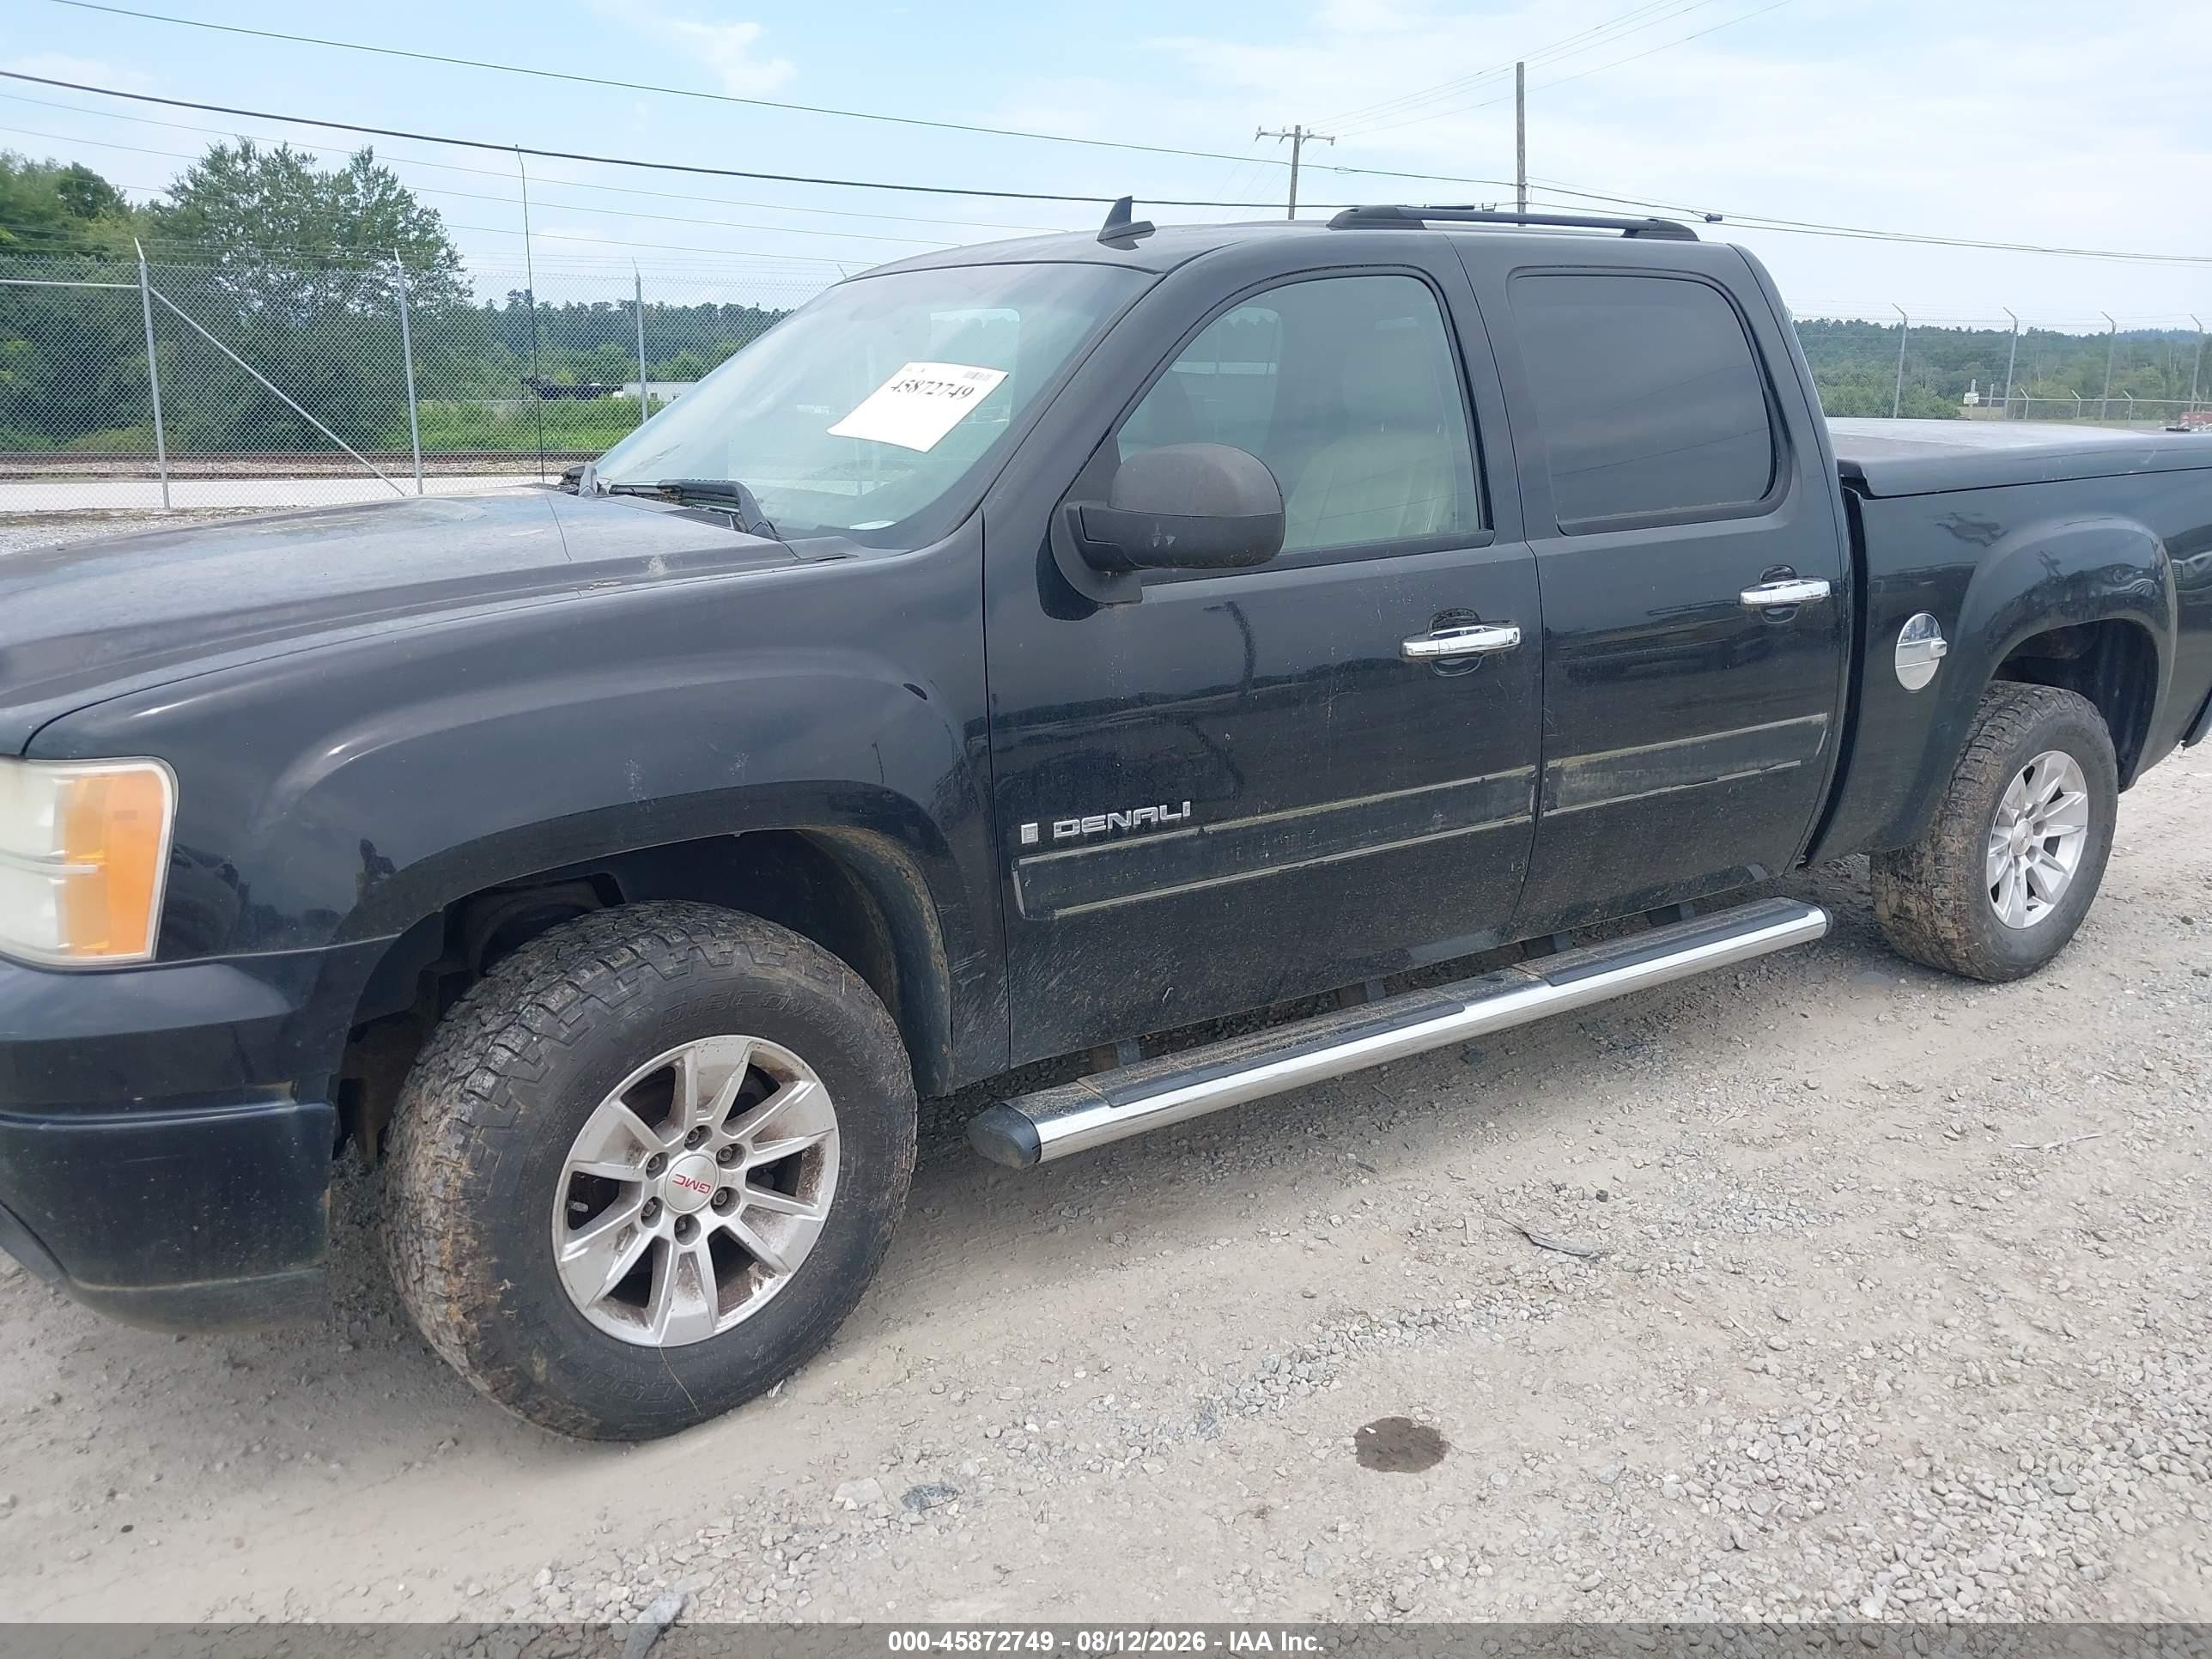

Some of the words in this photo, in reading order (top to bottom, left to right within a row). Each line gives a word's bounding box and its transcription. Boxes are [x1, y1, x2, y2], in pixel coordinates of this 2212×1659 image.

[890, 380, 975, 400] 45872749
[1053, 800, 1191, 839] DENALI
[672, 1173, 711, 1194] GMC
